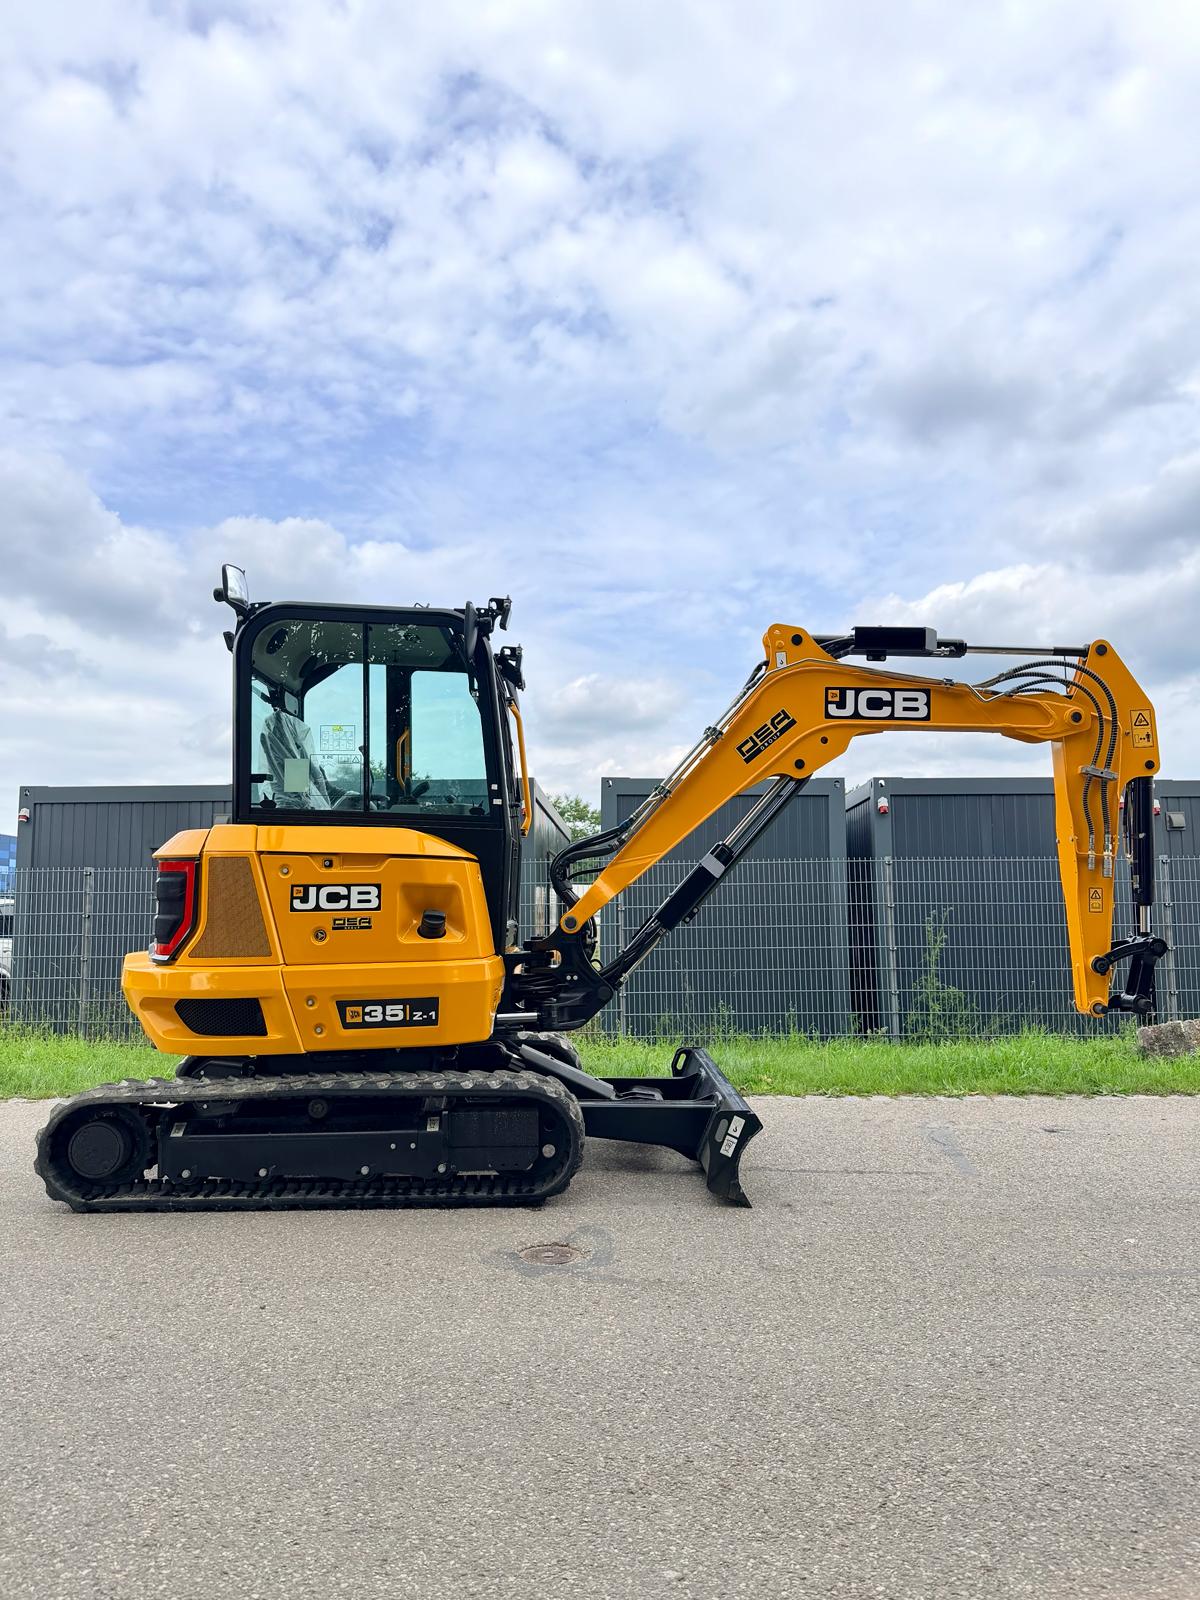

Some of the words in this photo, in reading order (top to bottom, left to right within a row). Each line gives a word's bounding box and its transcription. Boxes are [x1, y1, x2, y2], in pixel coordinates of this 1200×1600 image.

[827, 689, 928, 718] JCB
[293, 886, 379, 910] JCB
[364, 1005, 404, 1022] 35
[412, 1011, 436, 1020] Z-1
